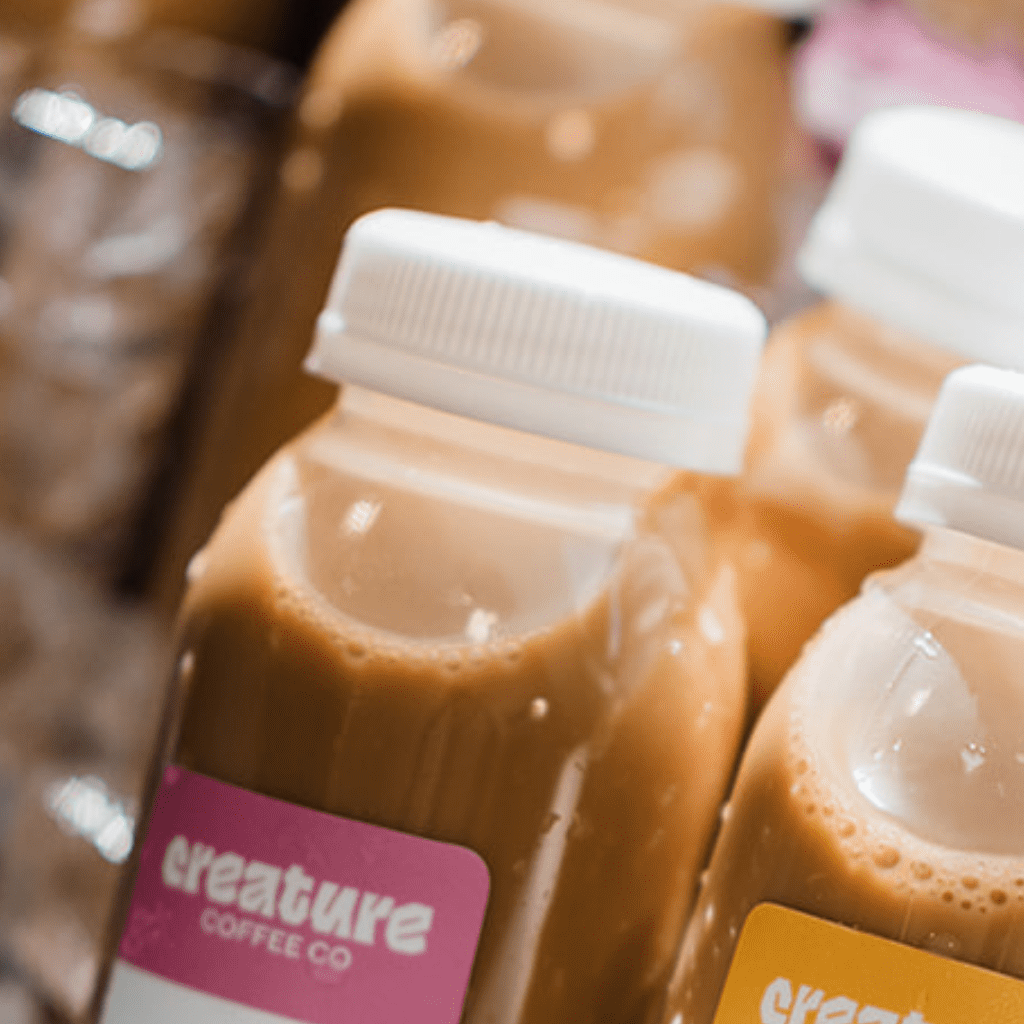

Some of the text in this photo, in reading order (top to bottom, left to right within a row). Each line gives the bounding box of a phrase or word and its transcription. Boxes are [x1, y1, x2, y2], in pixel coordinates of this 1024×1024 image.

[161, 834, 435, 954] creature
[201, 907, 352, 971] COFFEE CO
